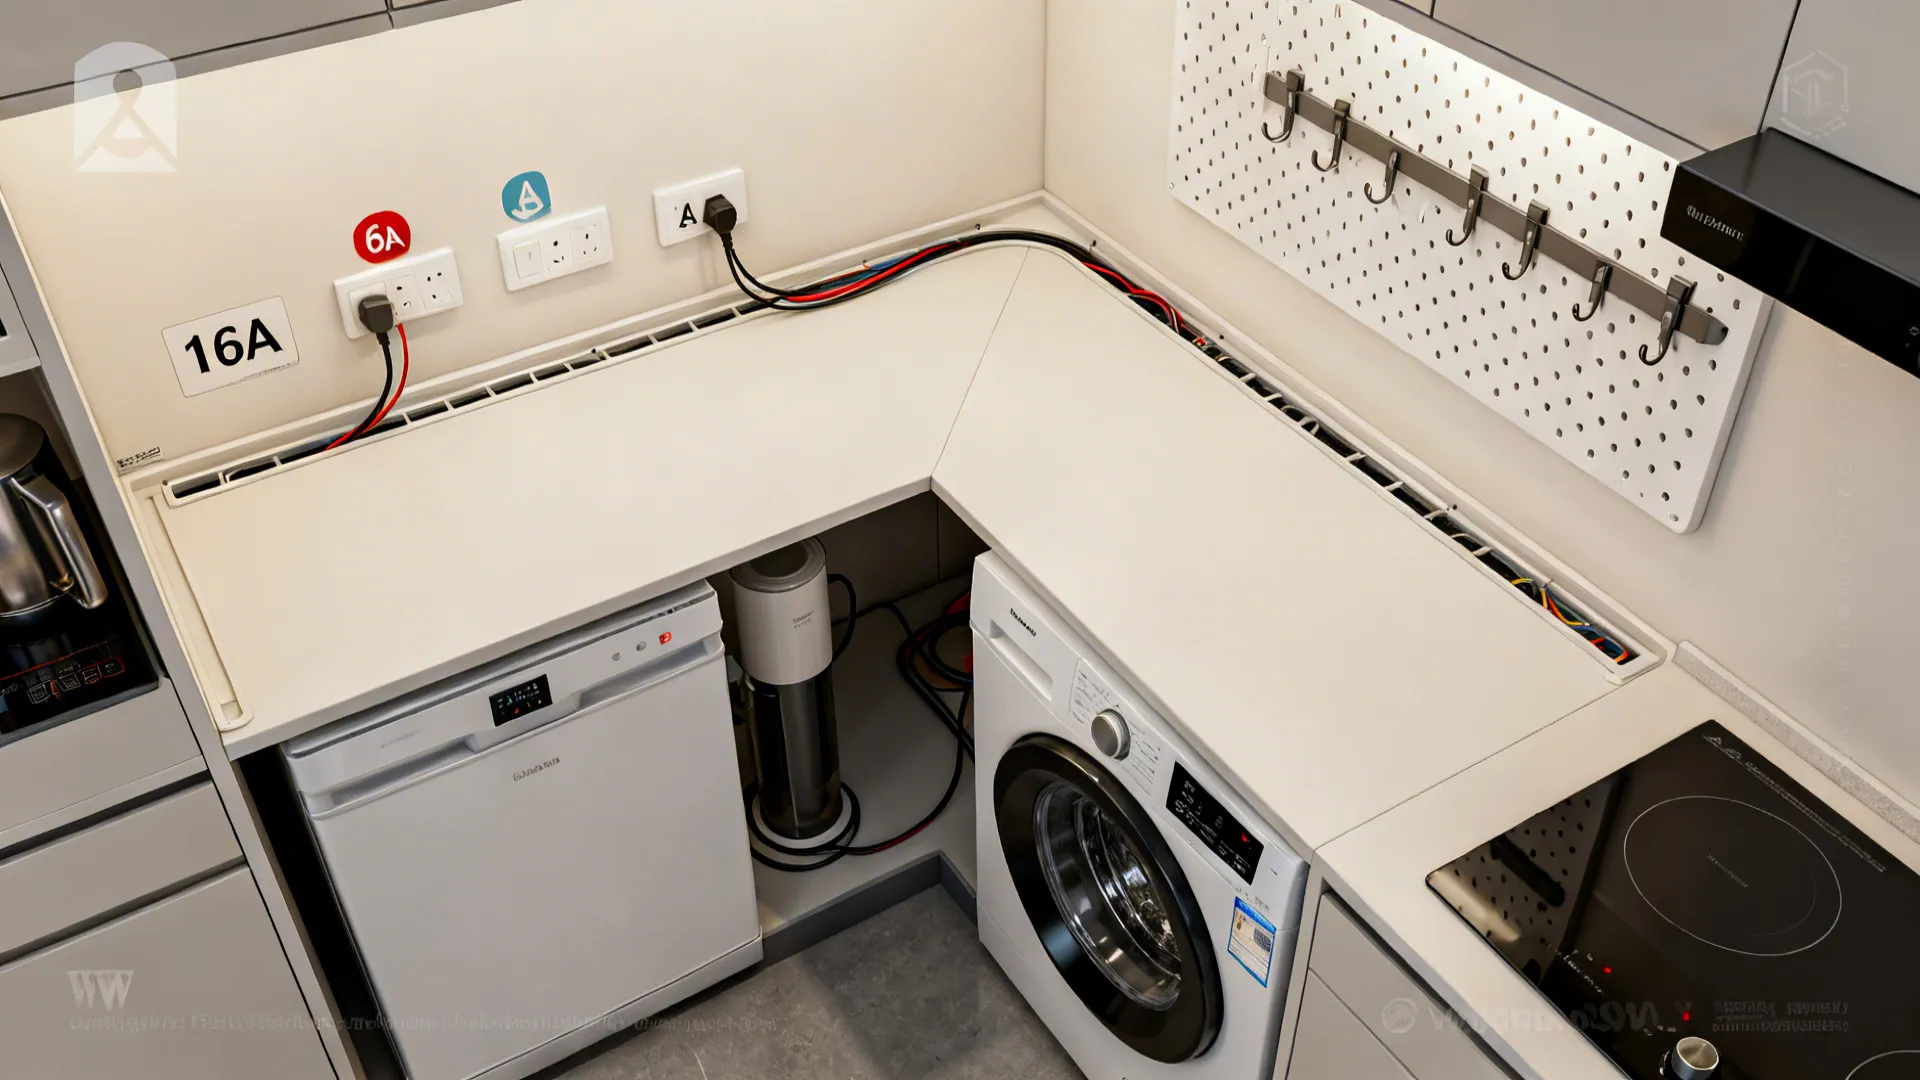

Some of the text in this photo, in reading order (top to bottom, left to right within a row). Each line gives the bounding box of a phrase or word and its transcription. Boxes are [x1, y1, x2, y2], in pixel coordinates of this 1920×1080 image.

[679, 202, 698, 228] A
[365, 223, 406, 254] 6A
[184, 317, 283, 374] 16A
